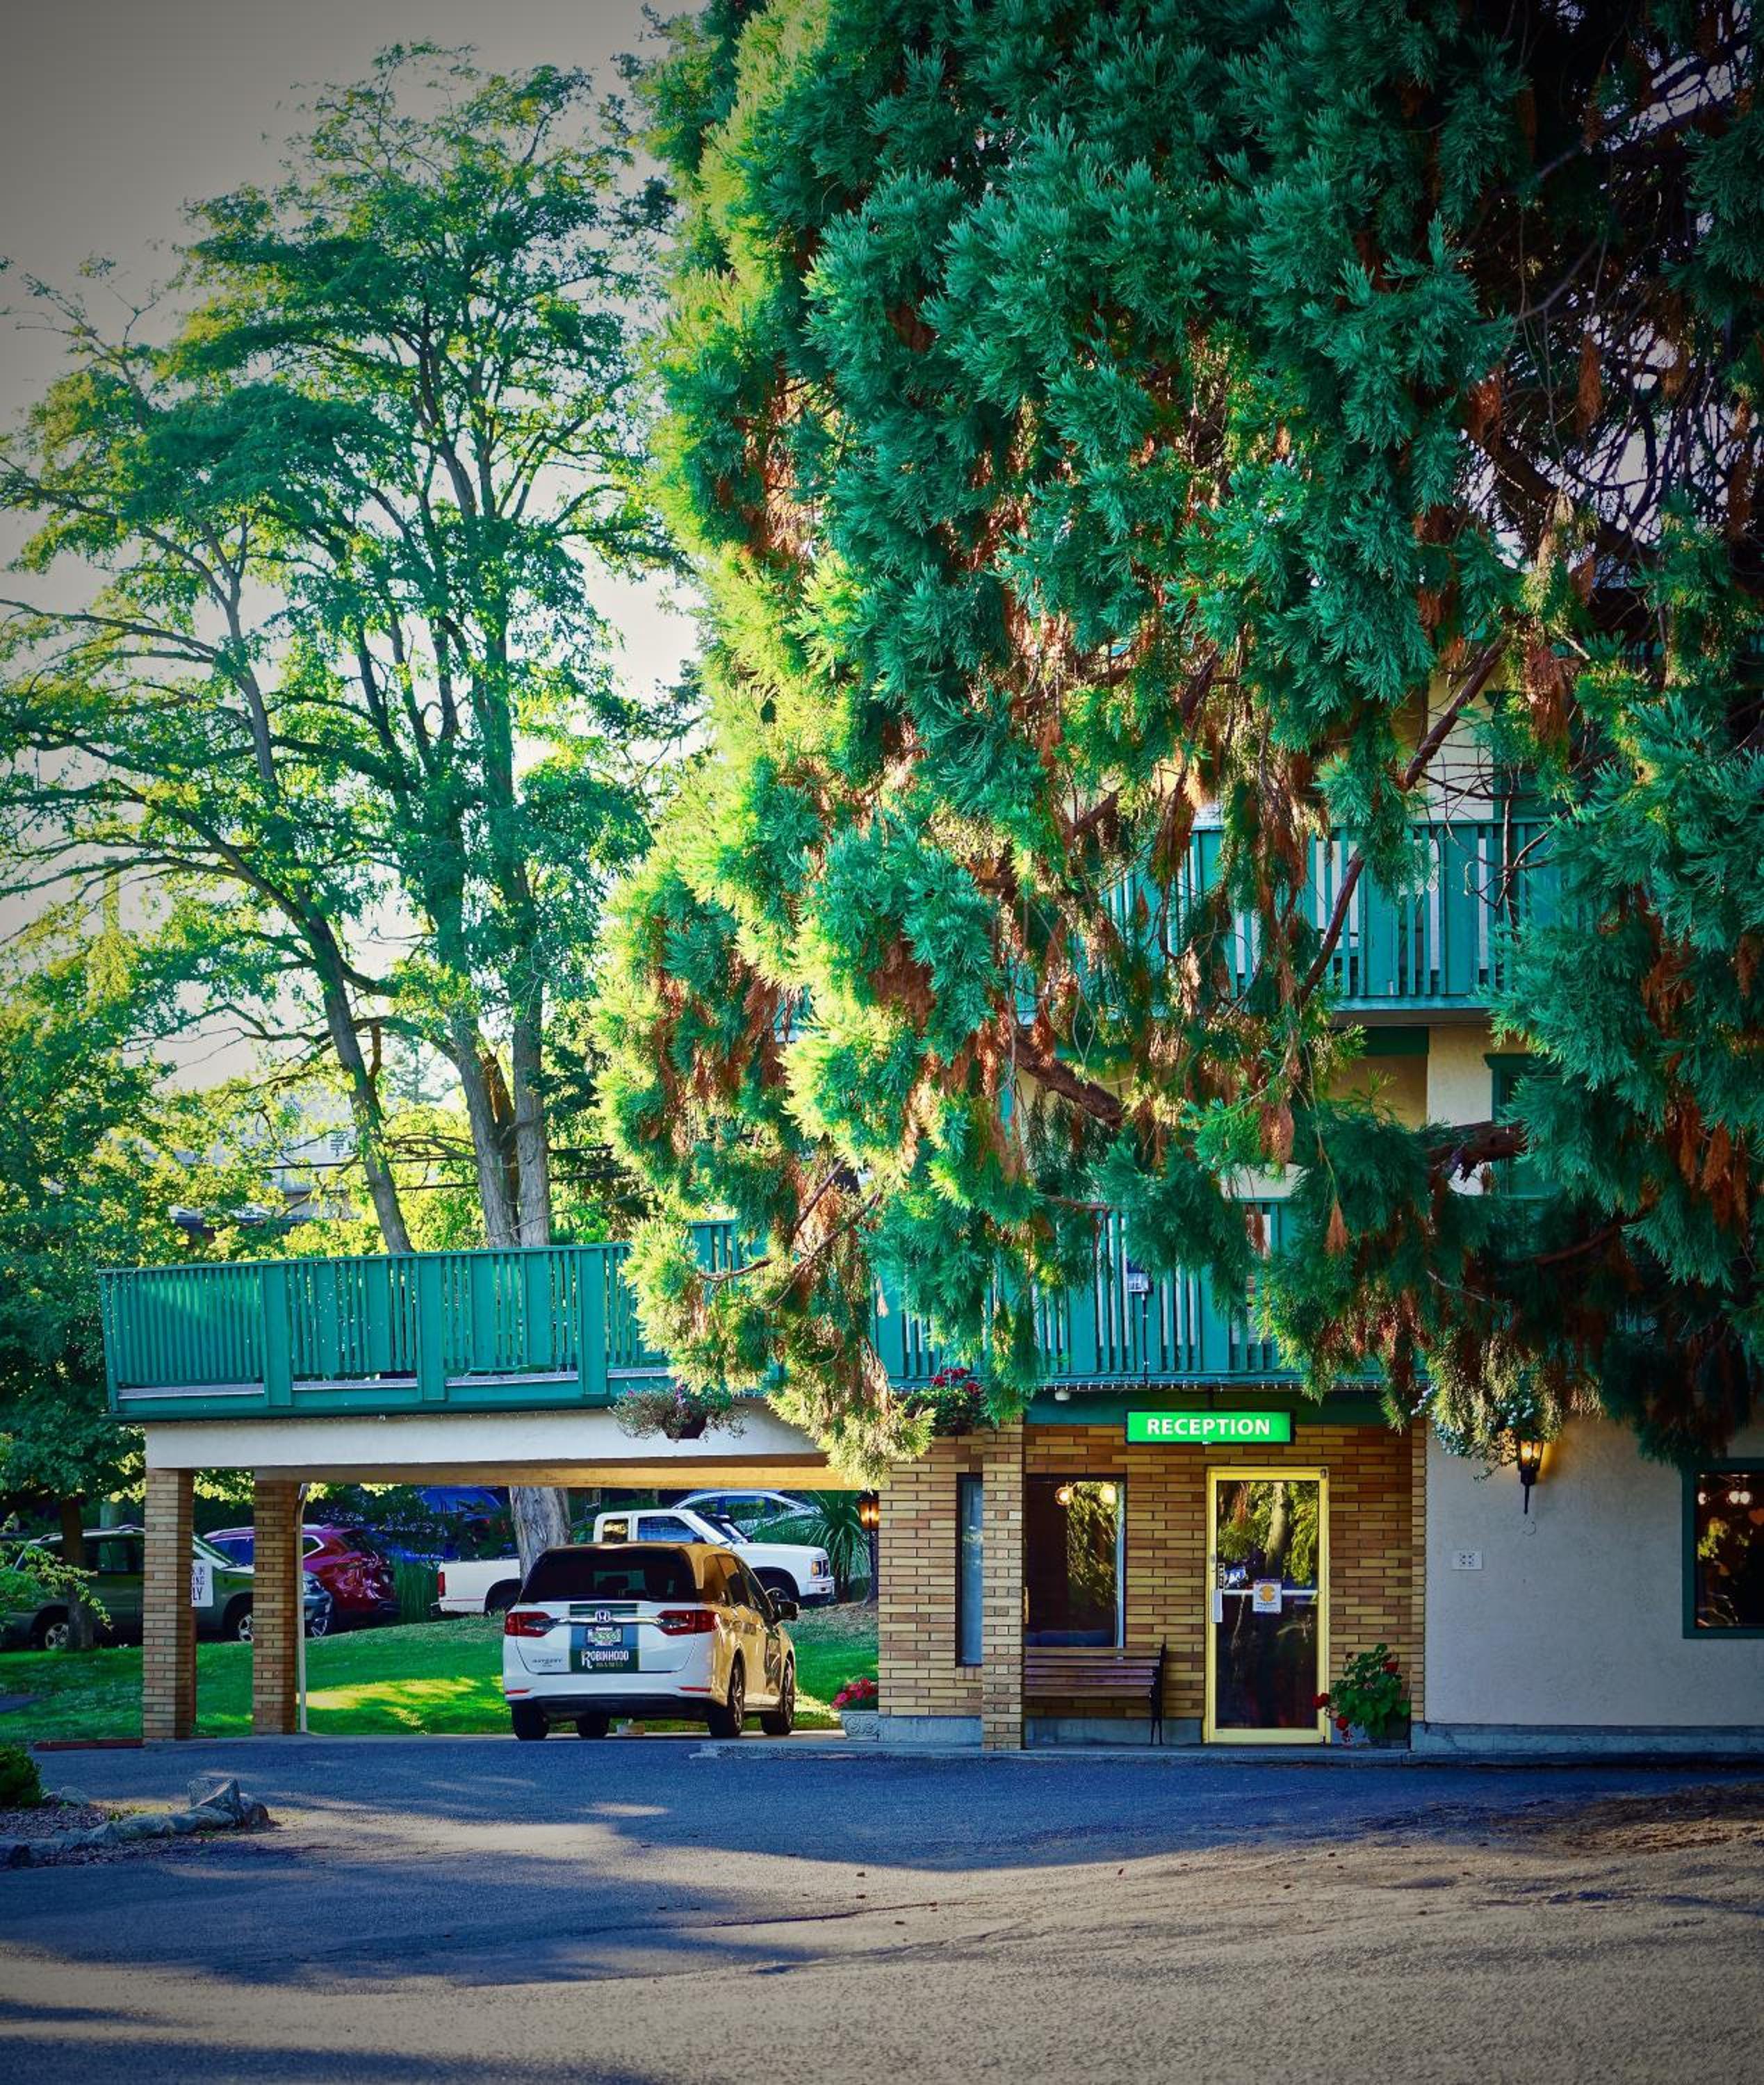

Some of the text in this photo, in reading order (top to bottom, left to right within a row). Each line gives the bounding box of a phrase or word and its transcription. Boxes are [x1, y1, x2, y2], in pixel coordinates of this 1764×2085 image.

[1148, 1418, 1270, 1435] RECEPTION
[193, 1576, 205, 1585] ING
[193, 1587, 202, 1601] LY
[581, 1650, 629, 1669] ROBINHOOD
